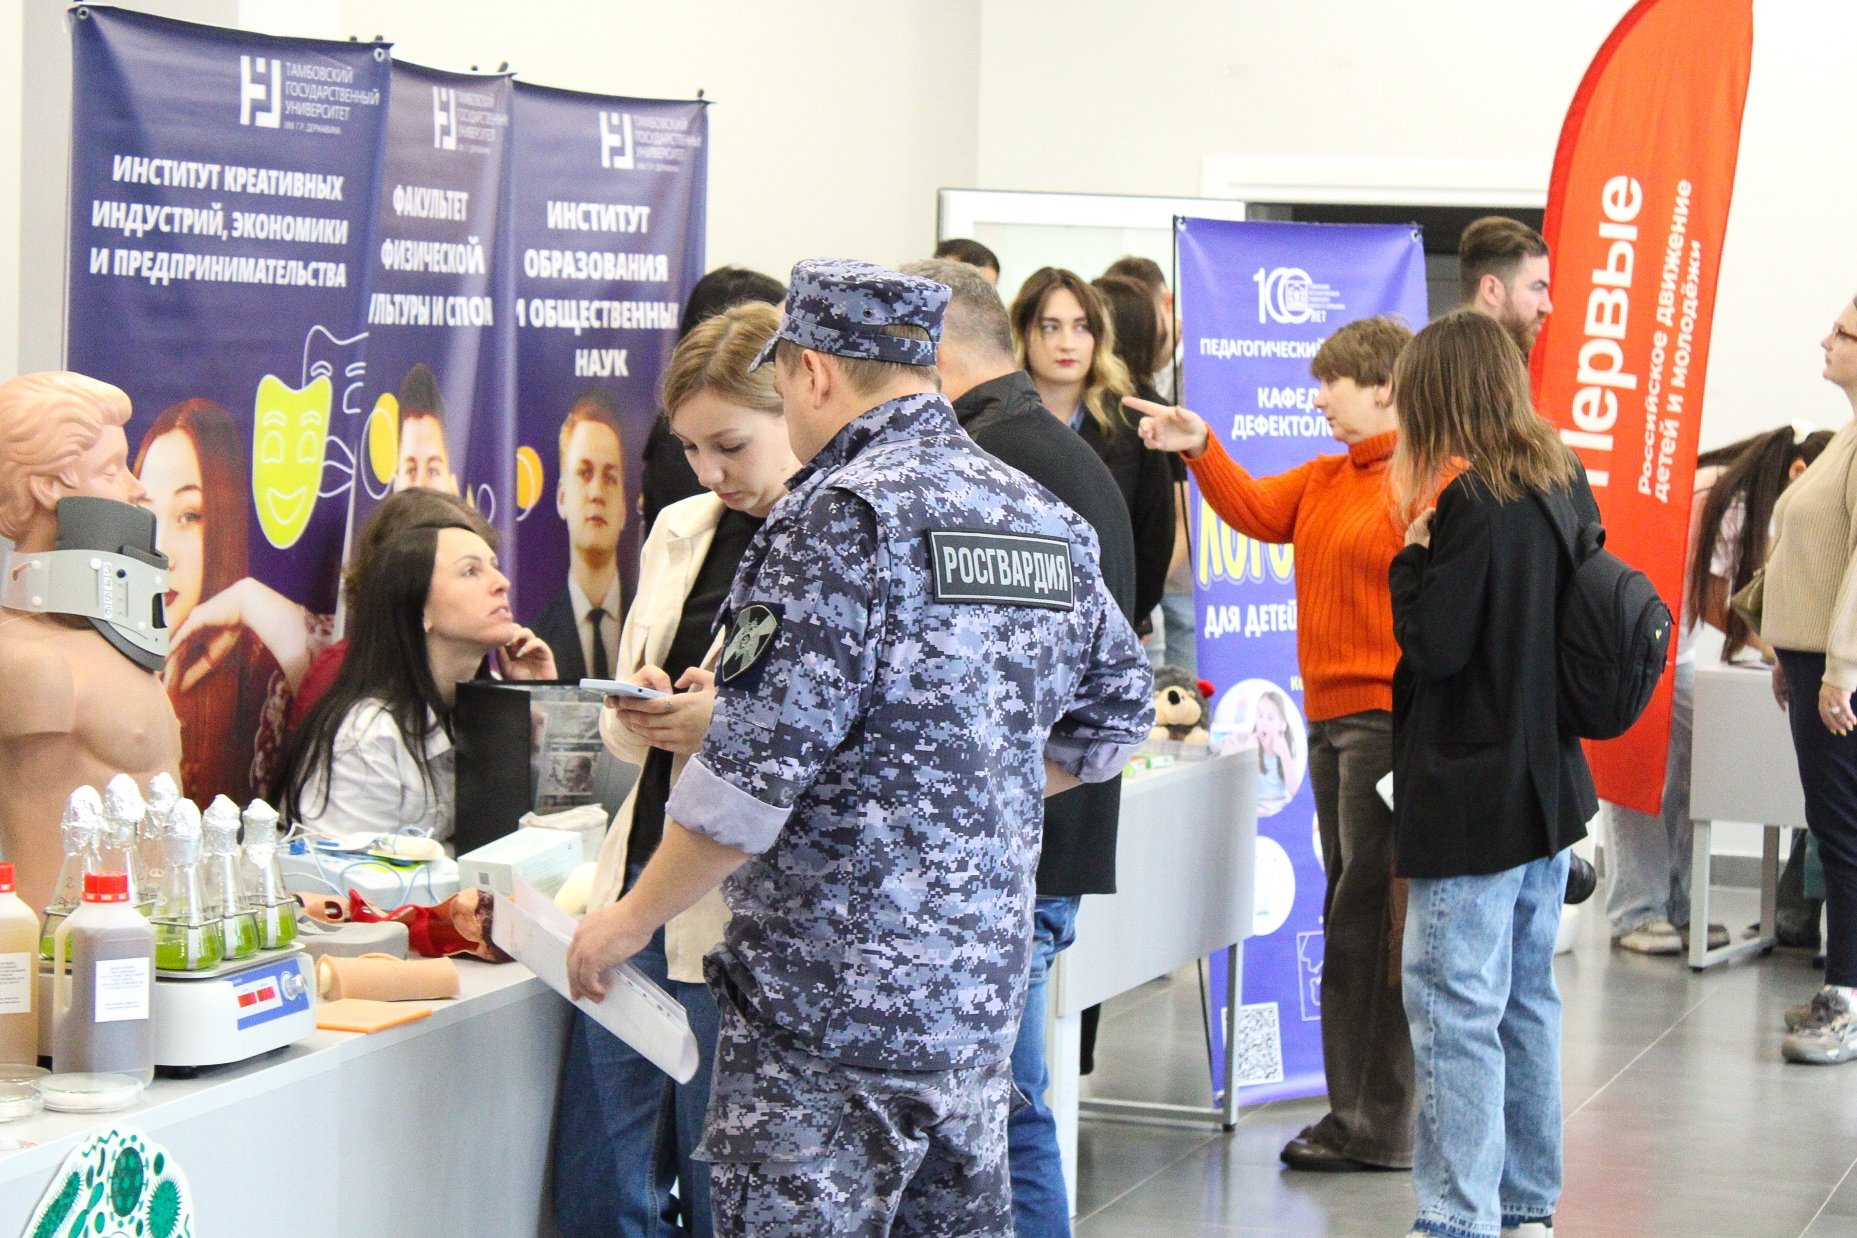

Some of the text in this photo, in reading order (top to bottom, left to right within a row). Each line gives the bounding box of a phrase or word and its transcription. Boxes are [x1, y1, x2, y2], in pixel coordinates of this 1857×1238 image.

[285, 62, 354, 84] ТАМБОВСКИЙ
[284, 100, 351, 121] УНИВЕРСИТЕТ
[285, 81, 380, 106] ГОСУДАРСТВЕННЫЙ
[112, 154, 345, 201] ИНСТИТУТ КРЕАТИВНЫХ
[393, 185, 469, 221] ФАКУЛЬТЕТ
[547, 200, 651, 234] ИНСТИТУТ
[91, 200, 349, 245] ИНДУСТРИЙ, ЭКОНОМИКИ
[89, 247, 348, 287] И ПРЕДПРИНИМАТЕЛЬСТВА
[381, 235, 485, 274] ФИЗИЧЕСКОЙ
[524, 248, 669, 282] ОБРАЗОВАНИЯ
[432, 295, 444, 326] И
[1200, 337, 1325, 360] ПЕДАГОГИЧЕСКИЙ
[1638, 178, 1692, 496] Российское движение
[575, 348, 629, 377] НАУК
[1655, 240, 1701, 504] детей и молодёжи
[943, 546, 1069, 594] РОСГВАРДИЯ
[1204, 605, 1241, 639] ДЛЯ
